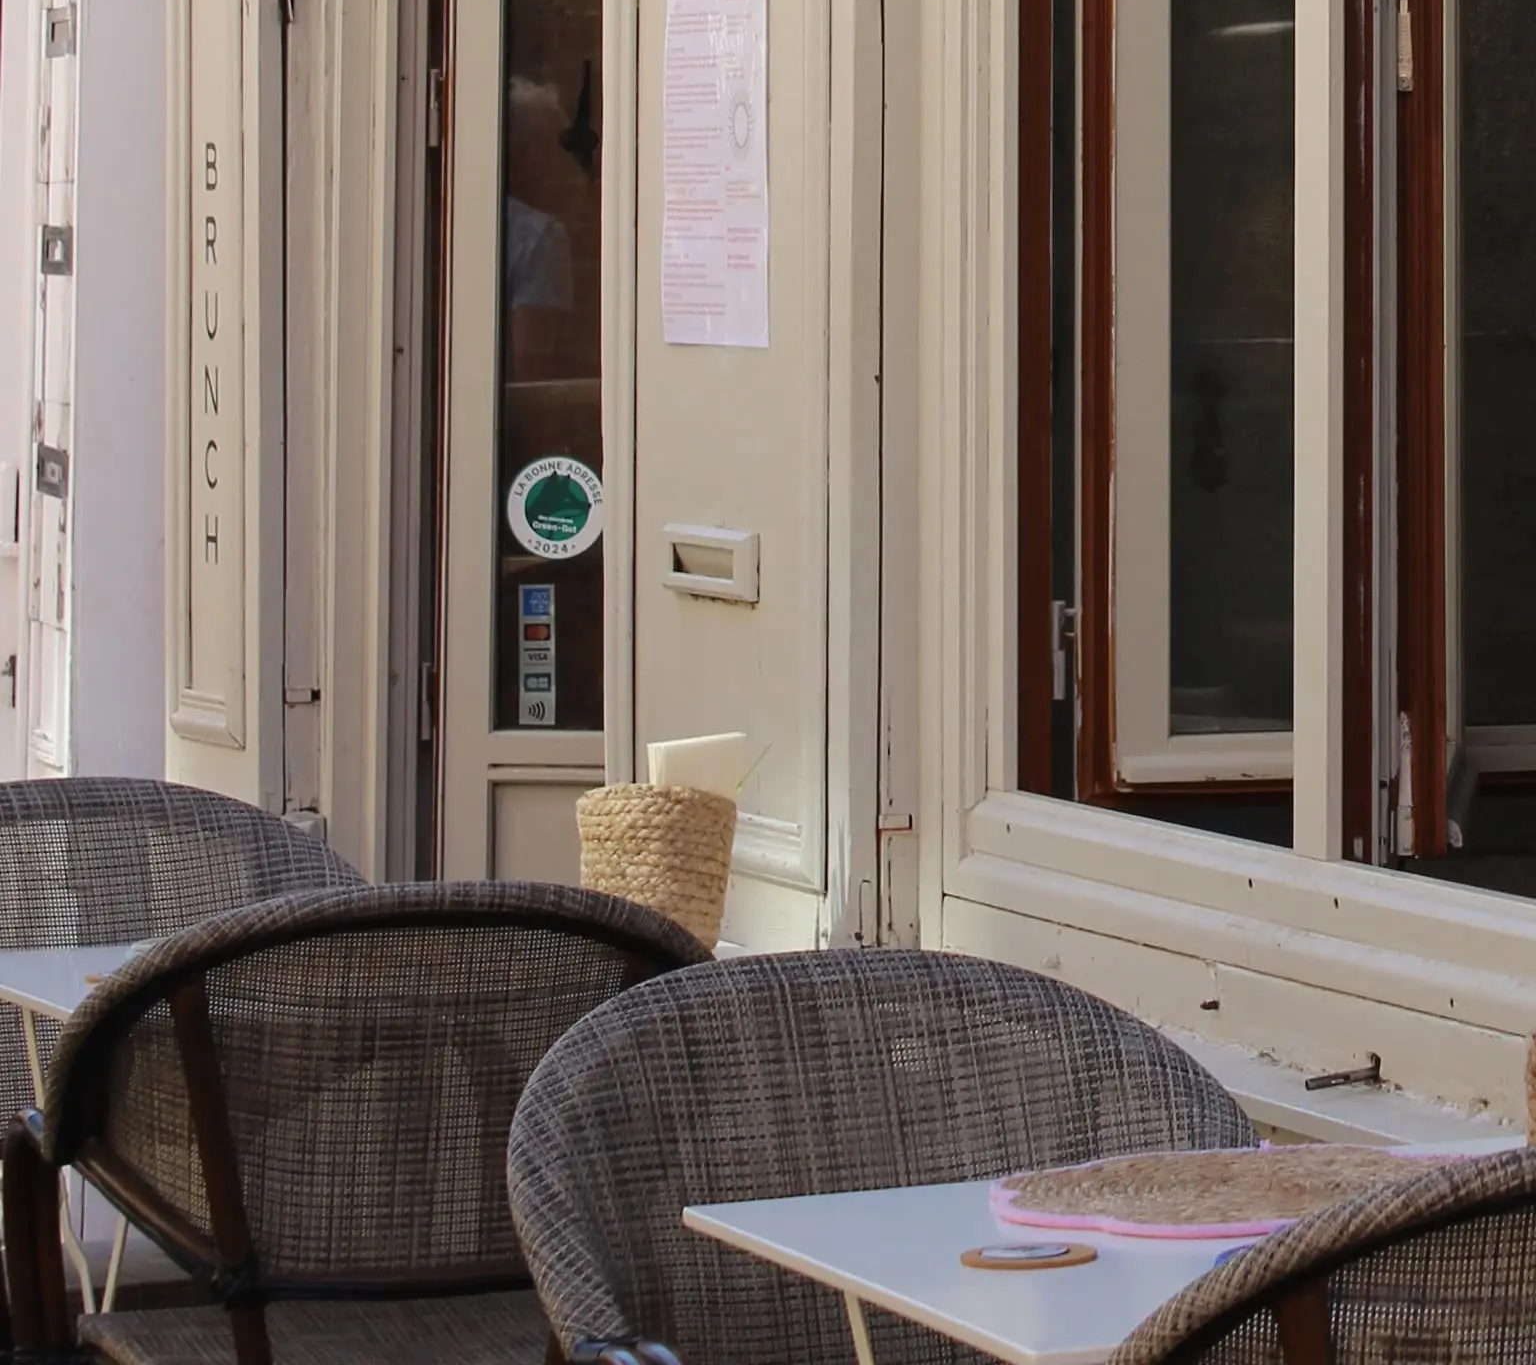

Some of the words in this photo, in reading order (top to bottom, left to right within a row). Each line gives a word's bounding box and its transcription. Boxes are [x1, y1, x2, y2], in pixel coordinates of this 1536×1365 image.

[204, 141, 220, 565] BRUNCH
[514, 481, 526, 497] LA
[524, 461, 562, 482] BONNE
[566, 464, 602, 506] ADRESSE
[533, 540, 569, 554] 2024
[528, 652, 548, 661] VISA
